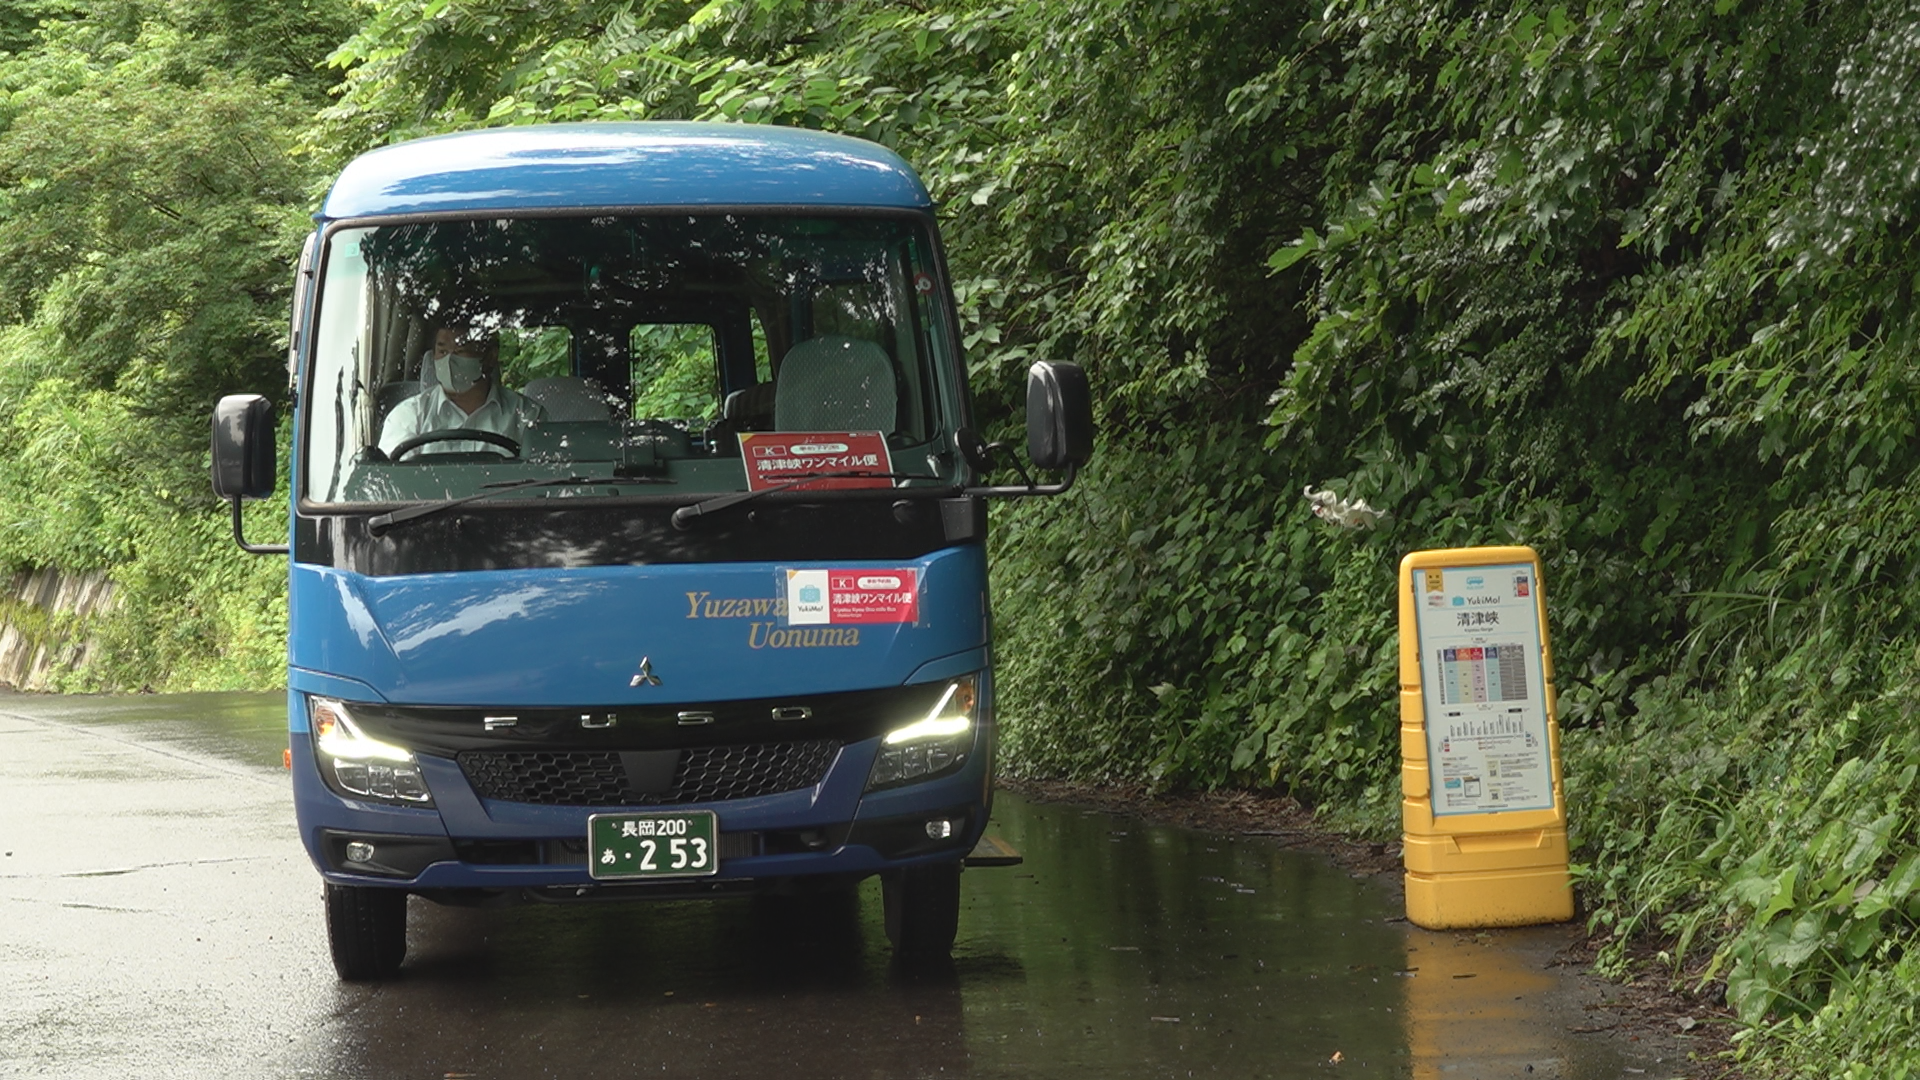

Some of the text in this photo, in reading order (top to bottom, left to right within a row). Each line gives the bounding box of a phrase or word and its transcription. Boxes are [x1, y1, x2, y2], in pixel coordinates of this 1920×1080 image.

[765, 447, 774, 456] K
[757, 454, 879, 471] 清津峡ワンマイル便
[839, 579, 847, 589] K
[685, 592, 789, 619] Yuzawa
[833, 592, 912, 605] 清津峡ワンマイル便
[1457, 611, 1500, 627] 清津峡
[748, 622, 860, 648] Uonuma
[485, 706, 812, 731] FUSO
[621, 819, 686, 838] 長岡200
[601, 848, 616, 864] あ
